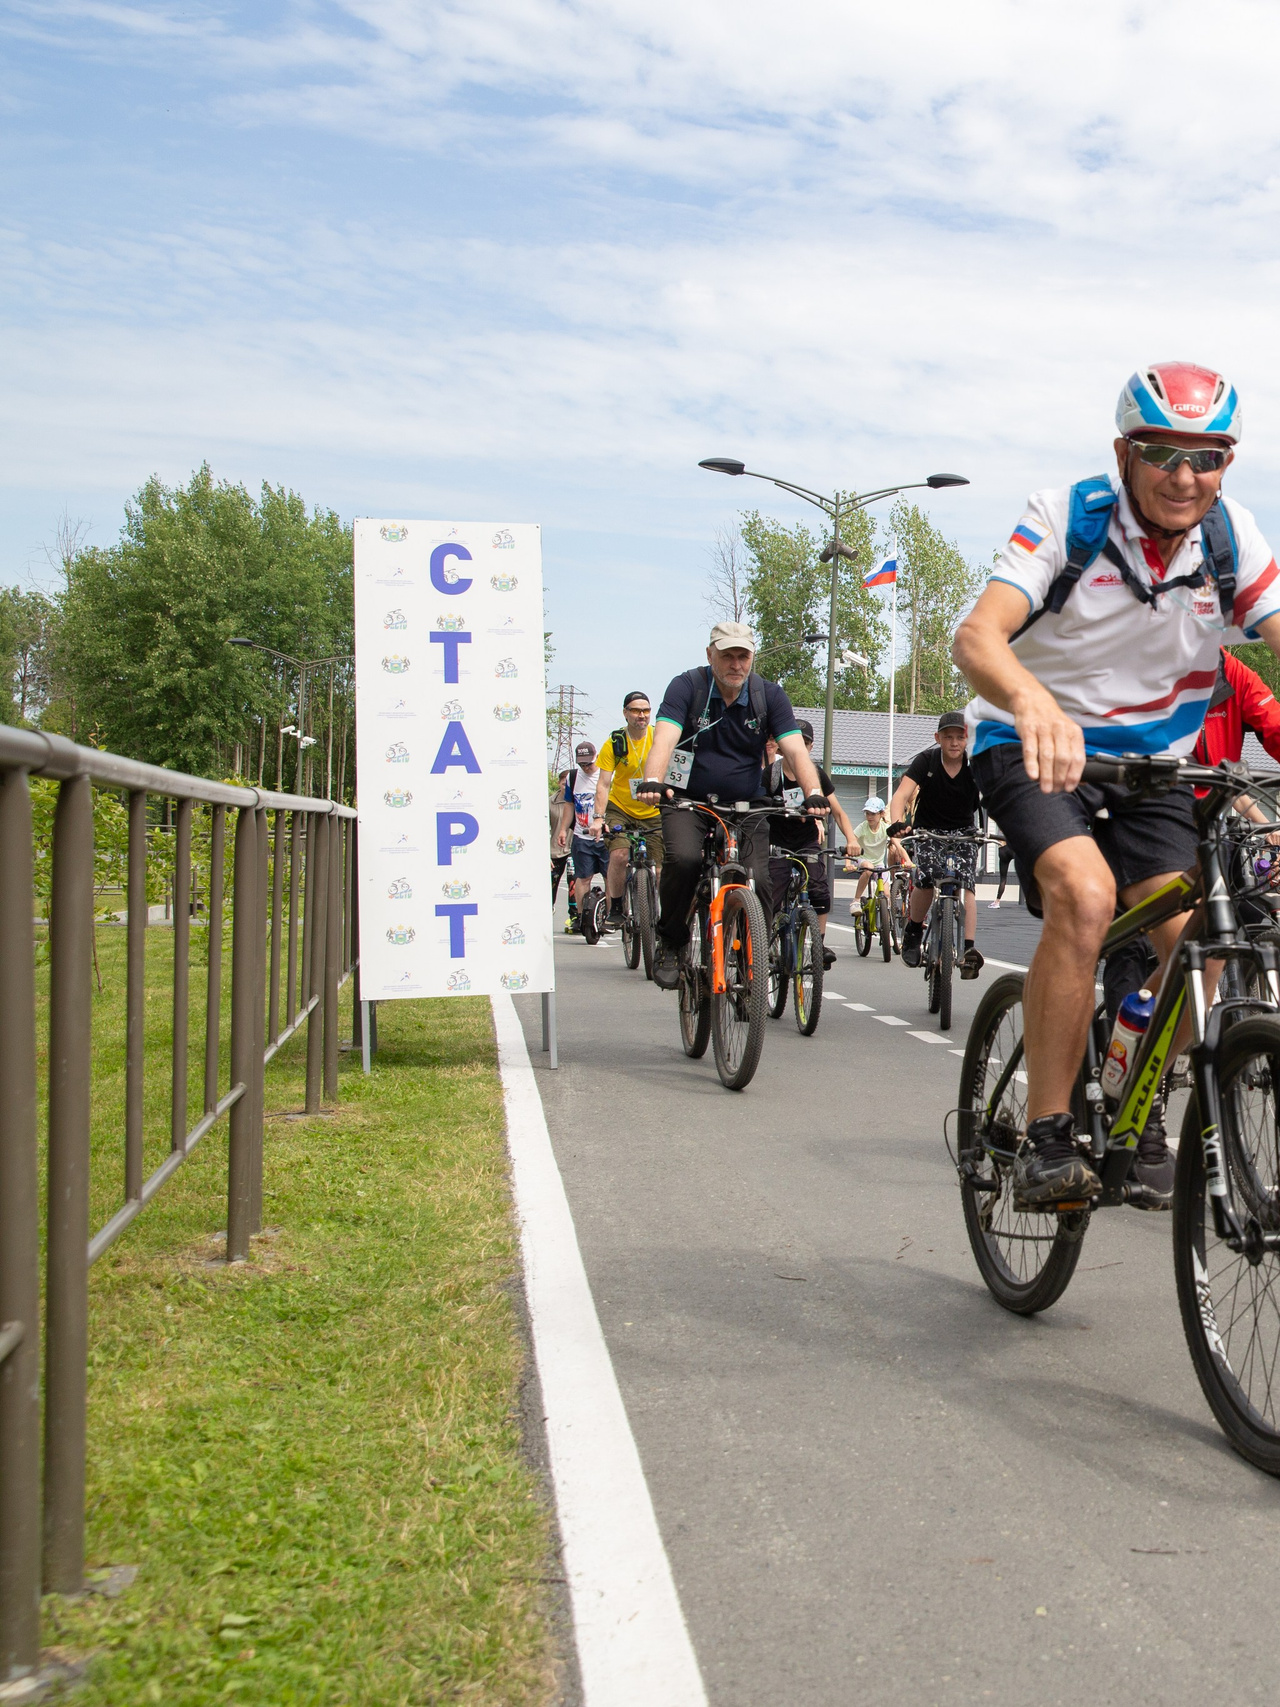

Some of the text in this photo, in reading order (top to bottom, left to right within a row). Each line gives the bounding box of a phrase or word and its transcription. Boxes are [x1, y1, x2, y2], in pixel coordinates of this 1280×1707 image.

[1172, 403, 1206, 414] GIRO
[430, 543, 482, 958] СТАРТ
[673, 754, 687, 764] 53
[669, 771, 683, 782] 53
[789, 791, 799, 800] 17
[1131, 1056, 1161, 1125] FUJI
